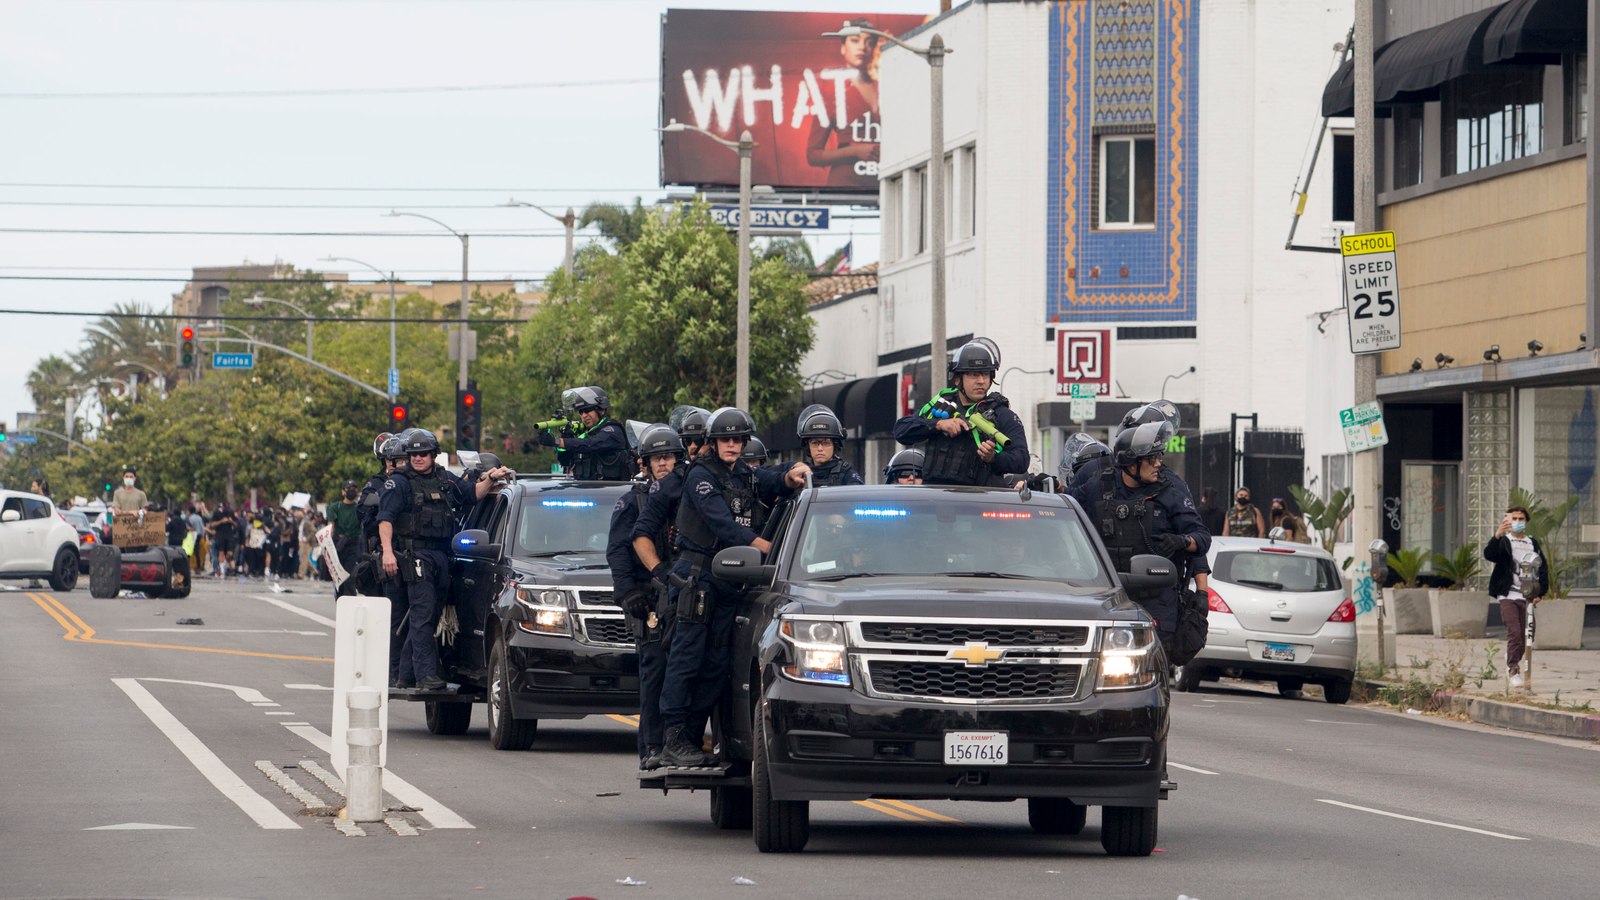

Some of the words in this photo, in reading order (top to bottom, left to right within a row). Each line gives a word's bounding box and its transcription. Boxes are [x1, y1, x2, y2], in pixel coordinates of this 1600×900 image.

[683, 64, 859, 133] WHAT
[854, 160, 880, 176] CB
[708, 207, 822, 227] EGENCY
[1344, 237, 1392, 252] SCHOOL
[1349, 260, 1393, 275] SPEED
[1355, 276, 1389, 289] LIMIT
[1353, 290, 1395, 319] 25
[1362, 330, 1391, 338] CHILDREN
[1371, 334, 1397, 343] PRESENT
[216, 356, 249, 366] Fairfax
[1072, 384, 1080, 395] 2
[1343, 410, 1352, 422] 2
[1355, 407, 1379, 420] PARKING
[949, 744, 1003, 760] 1567616
